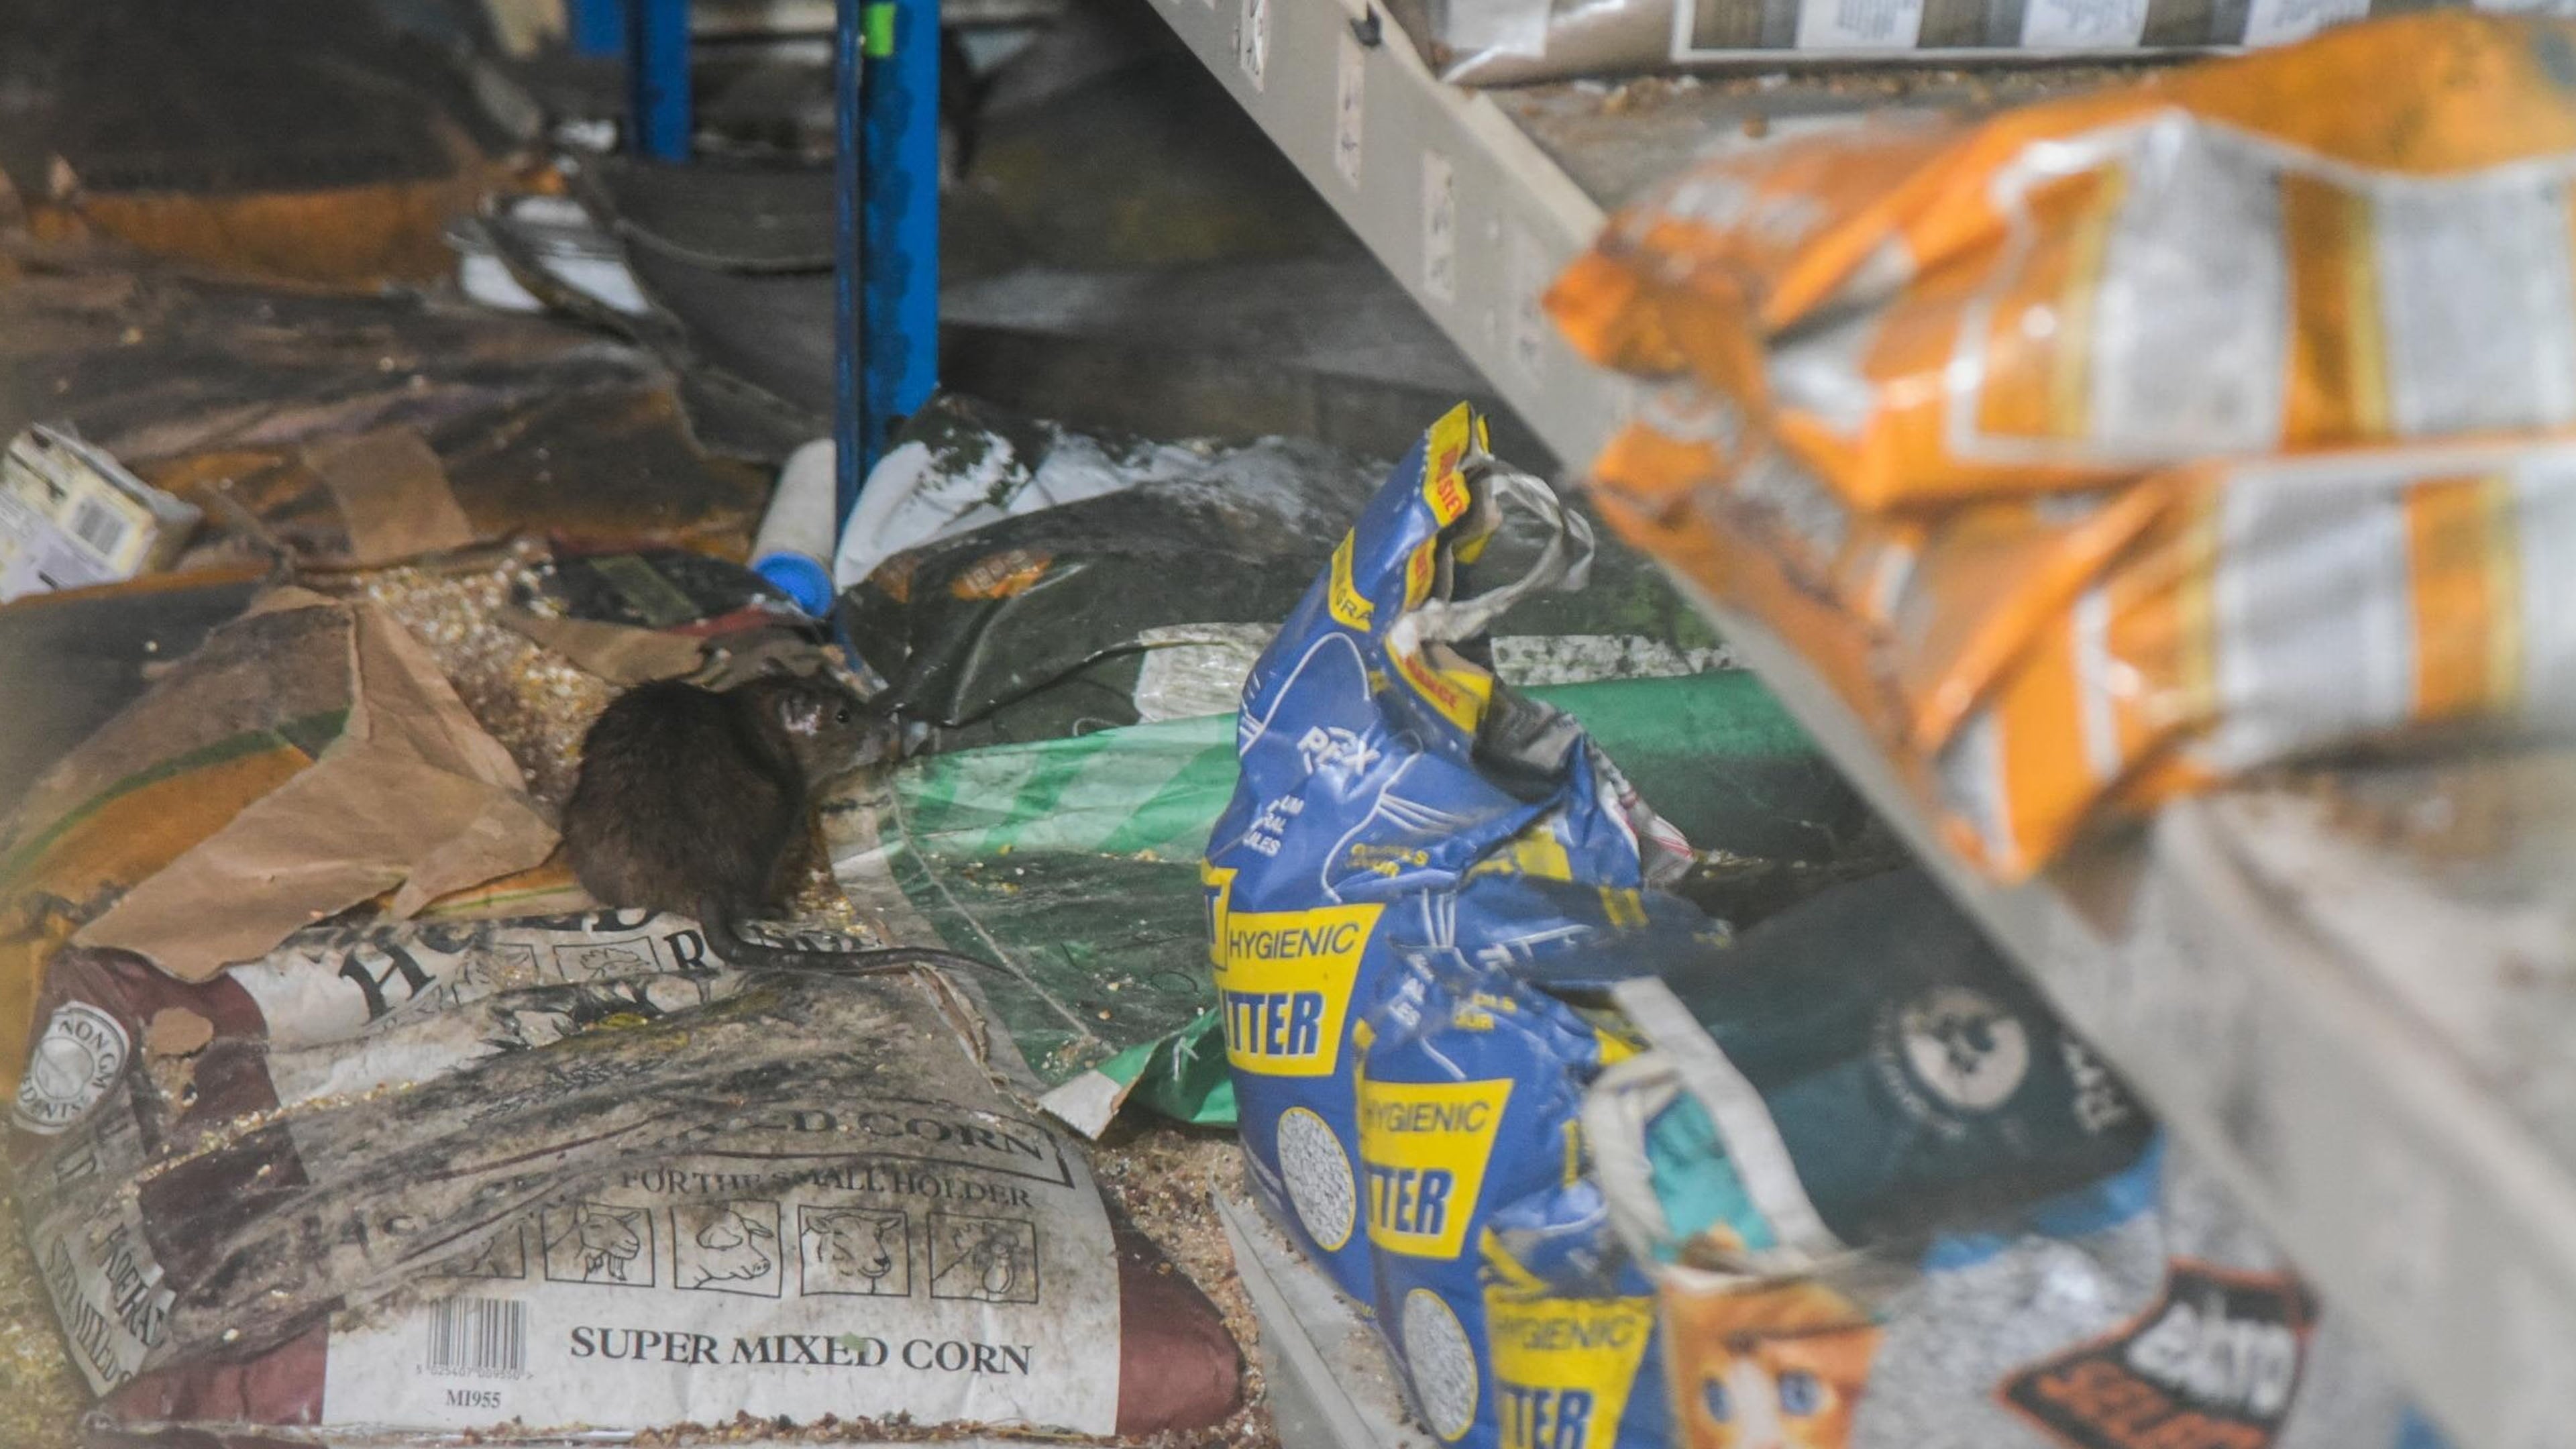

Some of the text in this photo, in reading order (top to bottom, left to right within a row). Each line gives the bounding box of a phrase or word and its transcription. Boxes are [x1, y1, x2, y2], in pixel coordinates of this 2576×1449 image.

[1229, 922, 1360, 960] HYGIENIC
[857, 1112, 1044, 1162] CORN
[570, 1326, 1033, 1375] SUPER MIXED CORN
[445, 1389, 502, 1409] MI955
